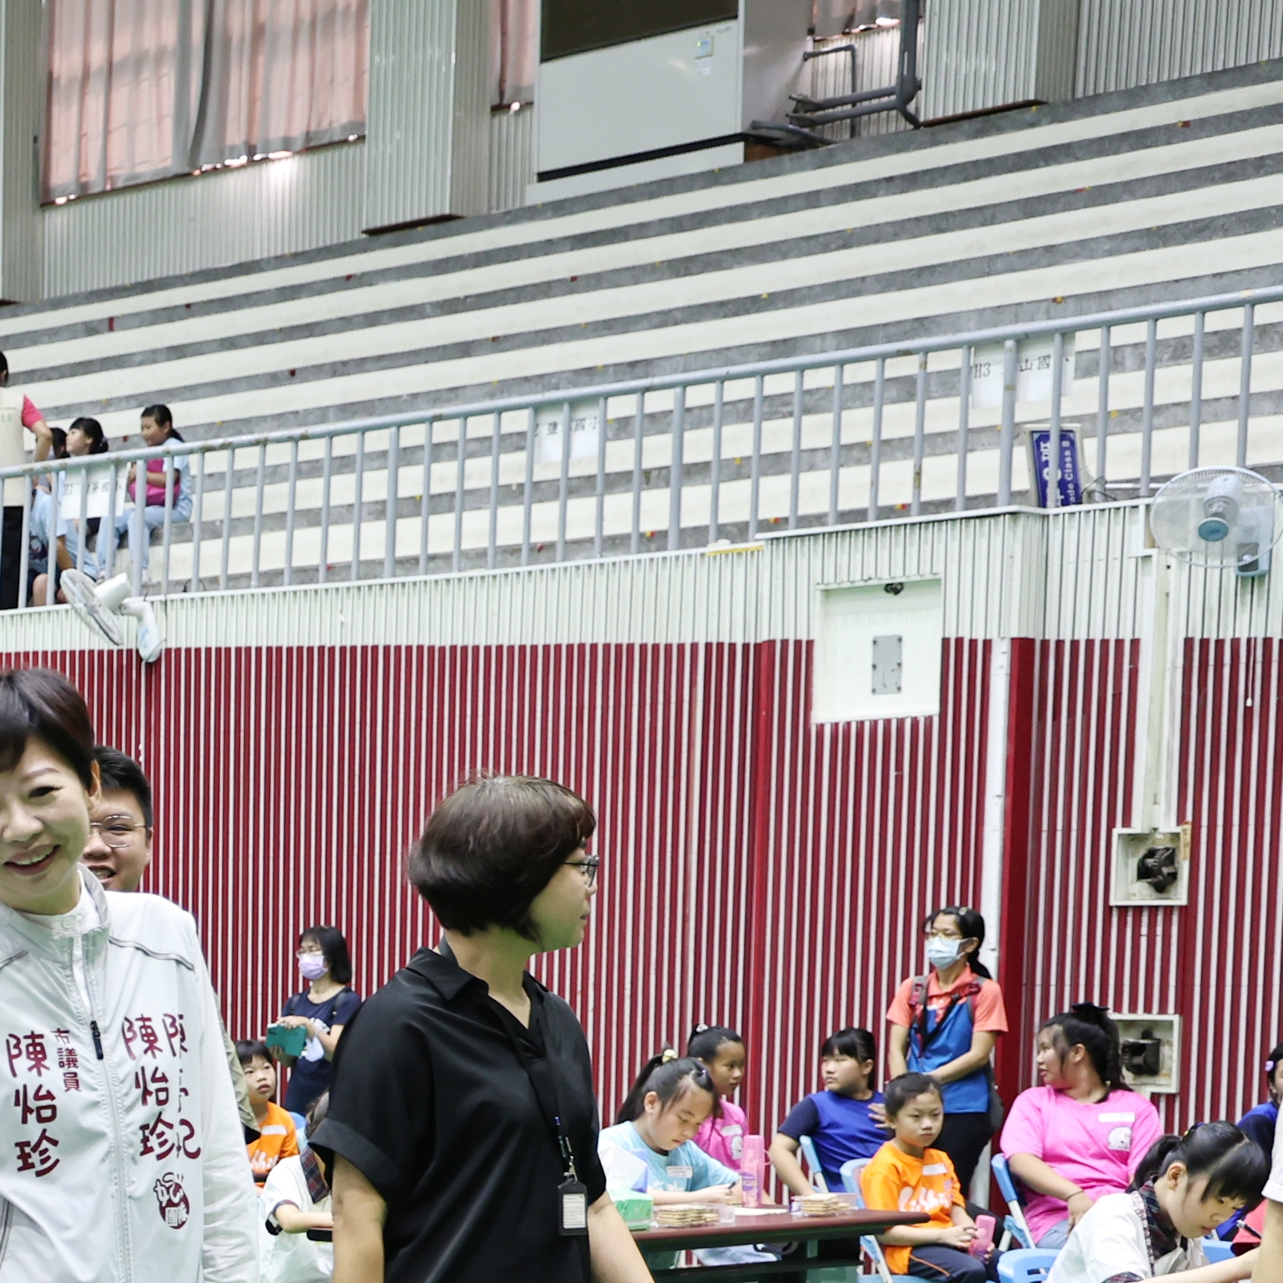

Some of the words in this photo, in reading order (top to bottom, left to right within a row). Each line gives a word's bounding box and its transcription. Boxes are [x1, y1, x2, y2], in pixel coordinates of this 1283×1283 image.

[1064, 450, 1074, 481] Class
[6, 1030, 61, 1178] 陳怡珍
[51, 1028, 82, 1092] 市議員
[122, 1013, 176, 1161] 陳怡珍
